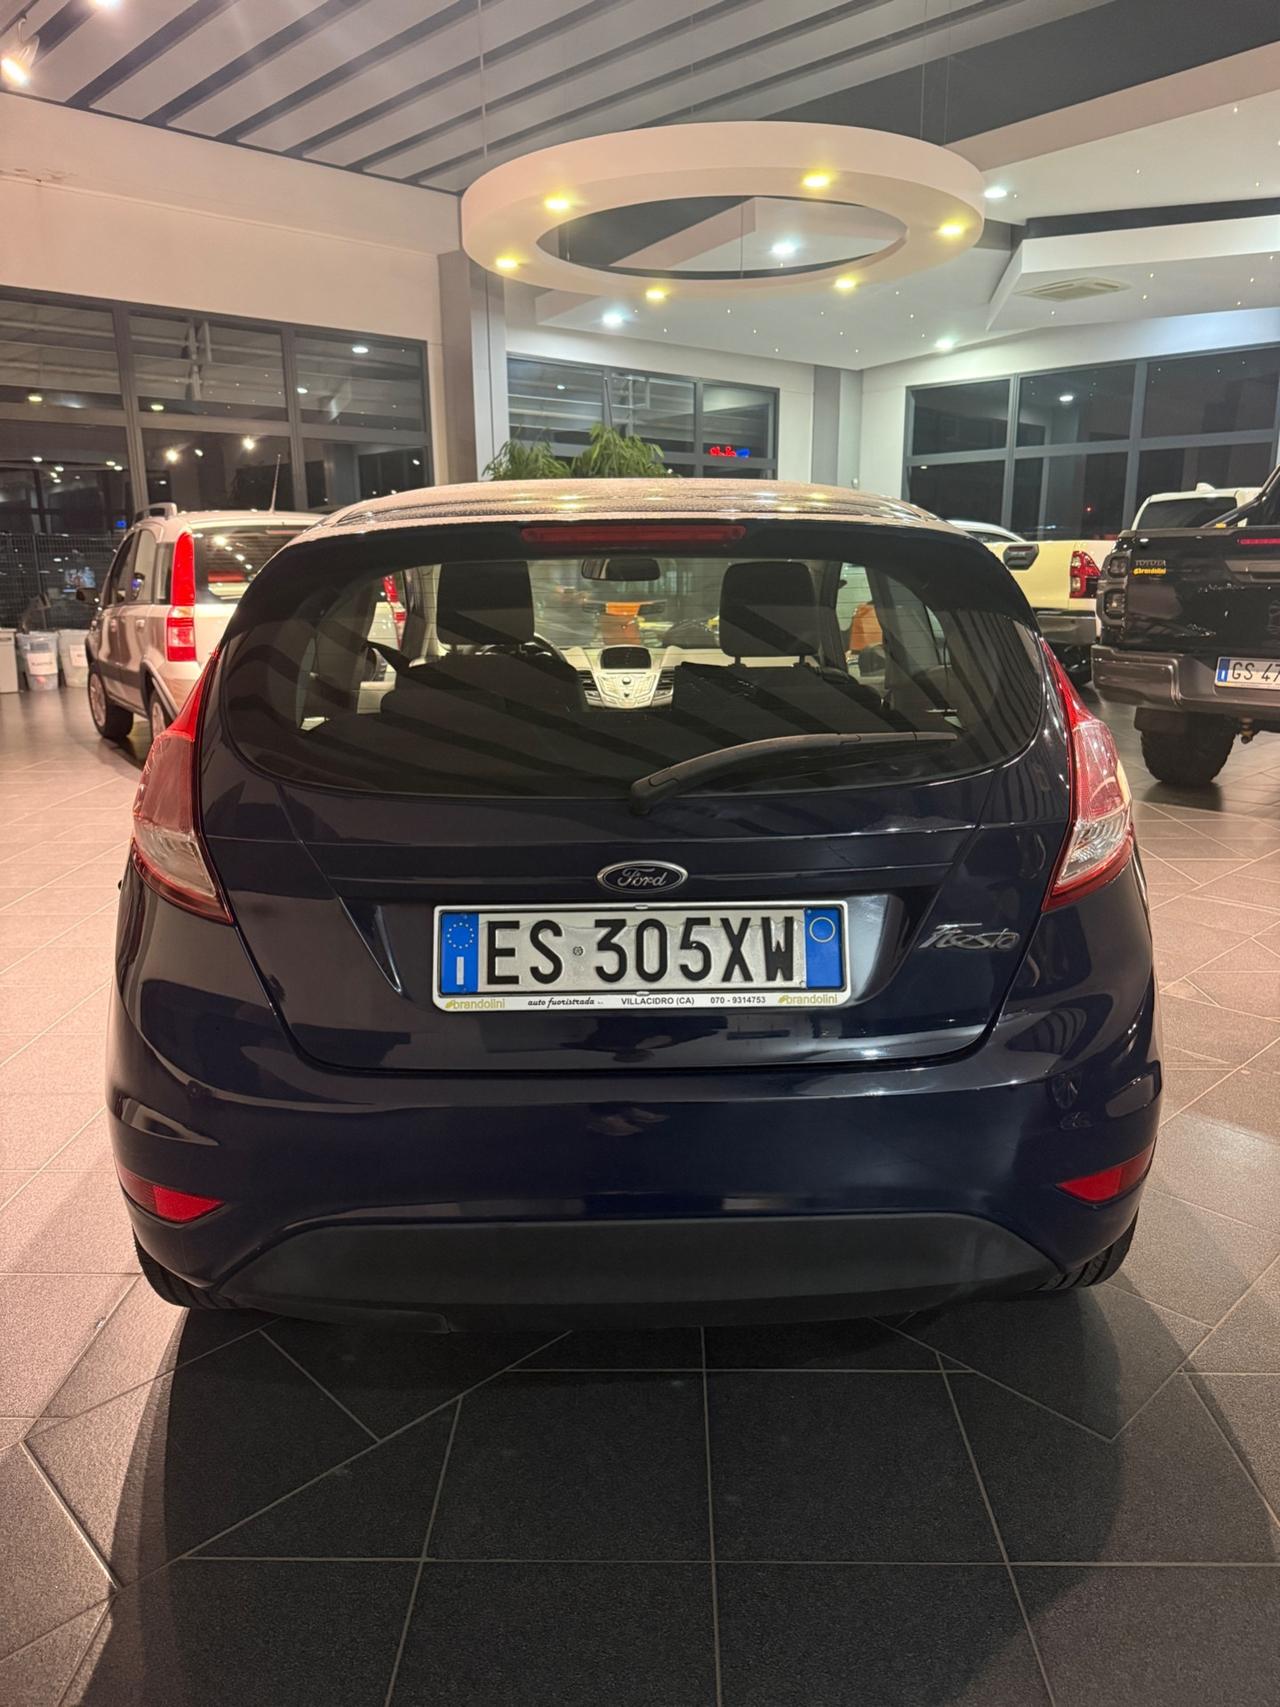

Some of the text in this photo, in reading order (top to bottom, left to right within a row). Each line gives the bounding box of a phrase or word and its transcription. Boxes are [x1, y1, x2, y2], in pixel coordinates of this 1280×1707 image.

[1232, 662, 1255, 680] GS
[616, 867, 668, 886] Ford
[918, 922, 1020, 949] Fiesta
[487, 916, 794, 985] ES 305XW
[456, 956, 465, 986] I
[452, 999, 506, 1009] brandolini
[527, 999, 546, 1007] auto
[547, 998, 595, 1008] fuoristrada
[621, 996, 694, 1006] VILLACIDRO (CA)
[710, 996, 725, 1004] 070
[732, 996, 766, 1004] 9314753
[785, 994, 838, 1005] brandolini
